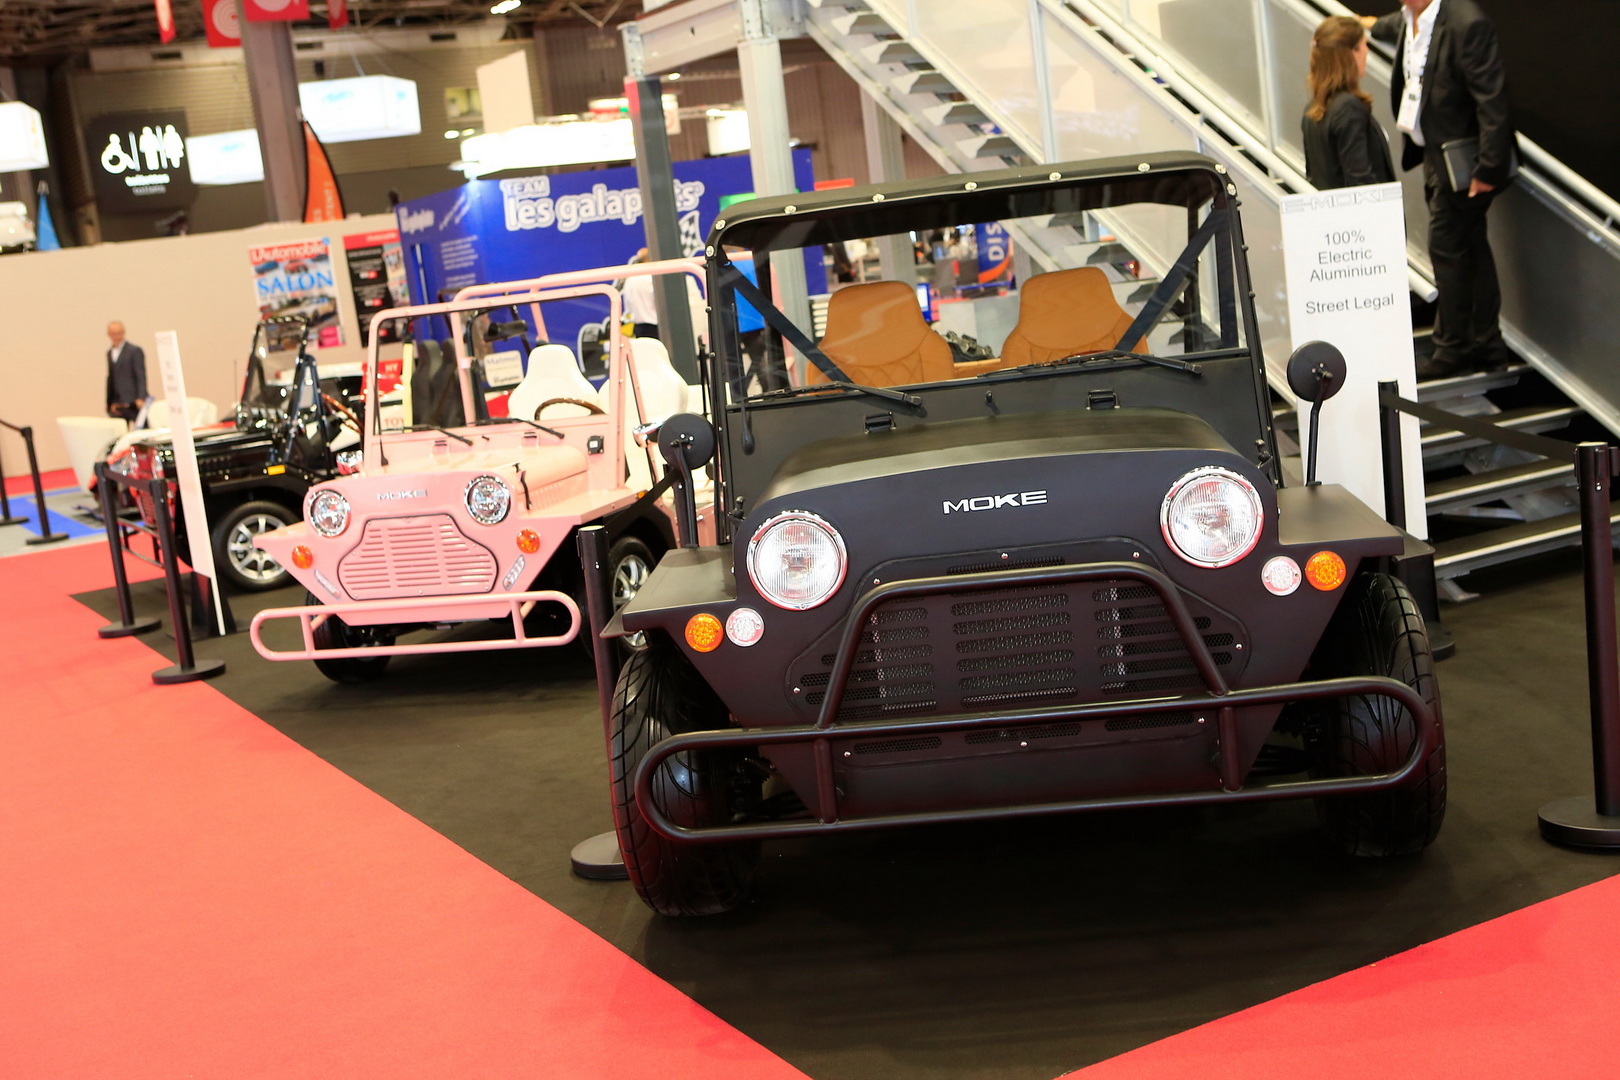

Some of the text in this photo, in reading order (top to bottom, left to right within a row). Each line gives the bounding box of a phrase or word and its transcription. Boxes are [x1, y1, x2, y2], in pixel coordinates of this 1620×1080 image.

[505, 178, 548, 197] TEAM
[506, 194, 553, 228] les
[1325, 230, 1366, 245] 100%
[1318, 248, 1373, 265] Electric
[1309, 264, 1387, 282] Aluminium
[257, 271, 333, 296] SALON
[1306, 293, 1395, 315] Street Legal
[376, 489, 428, 501] MOKE
[943, 489, 1048, 514] MOKE
